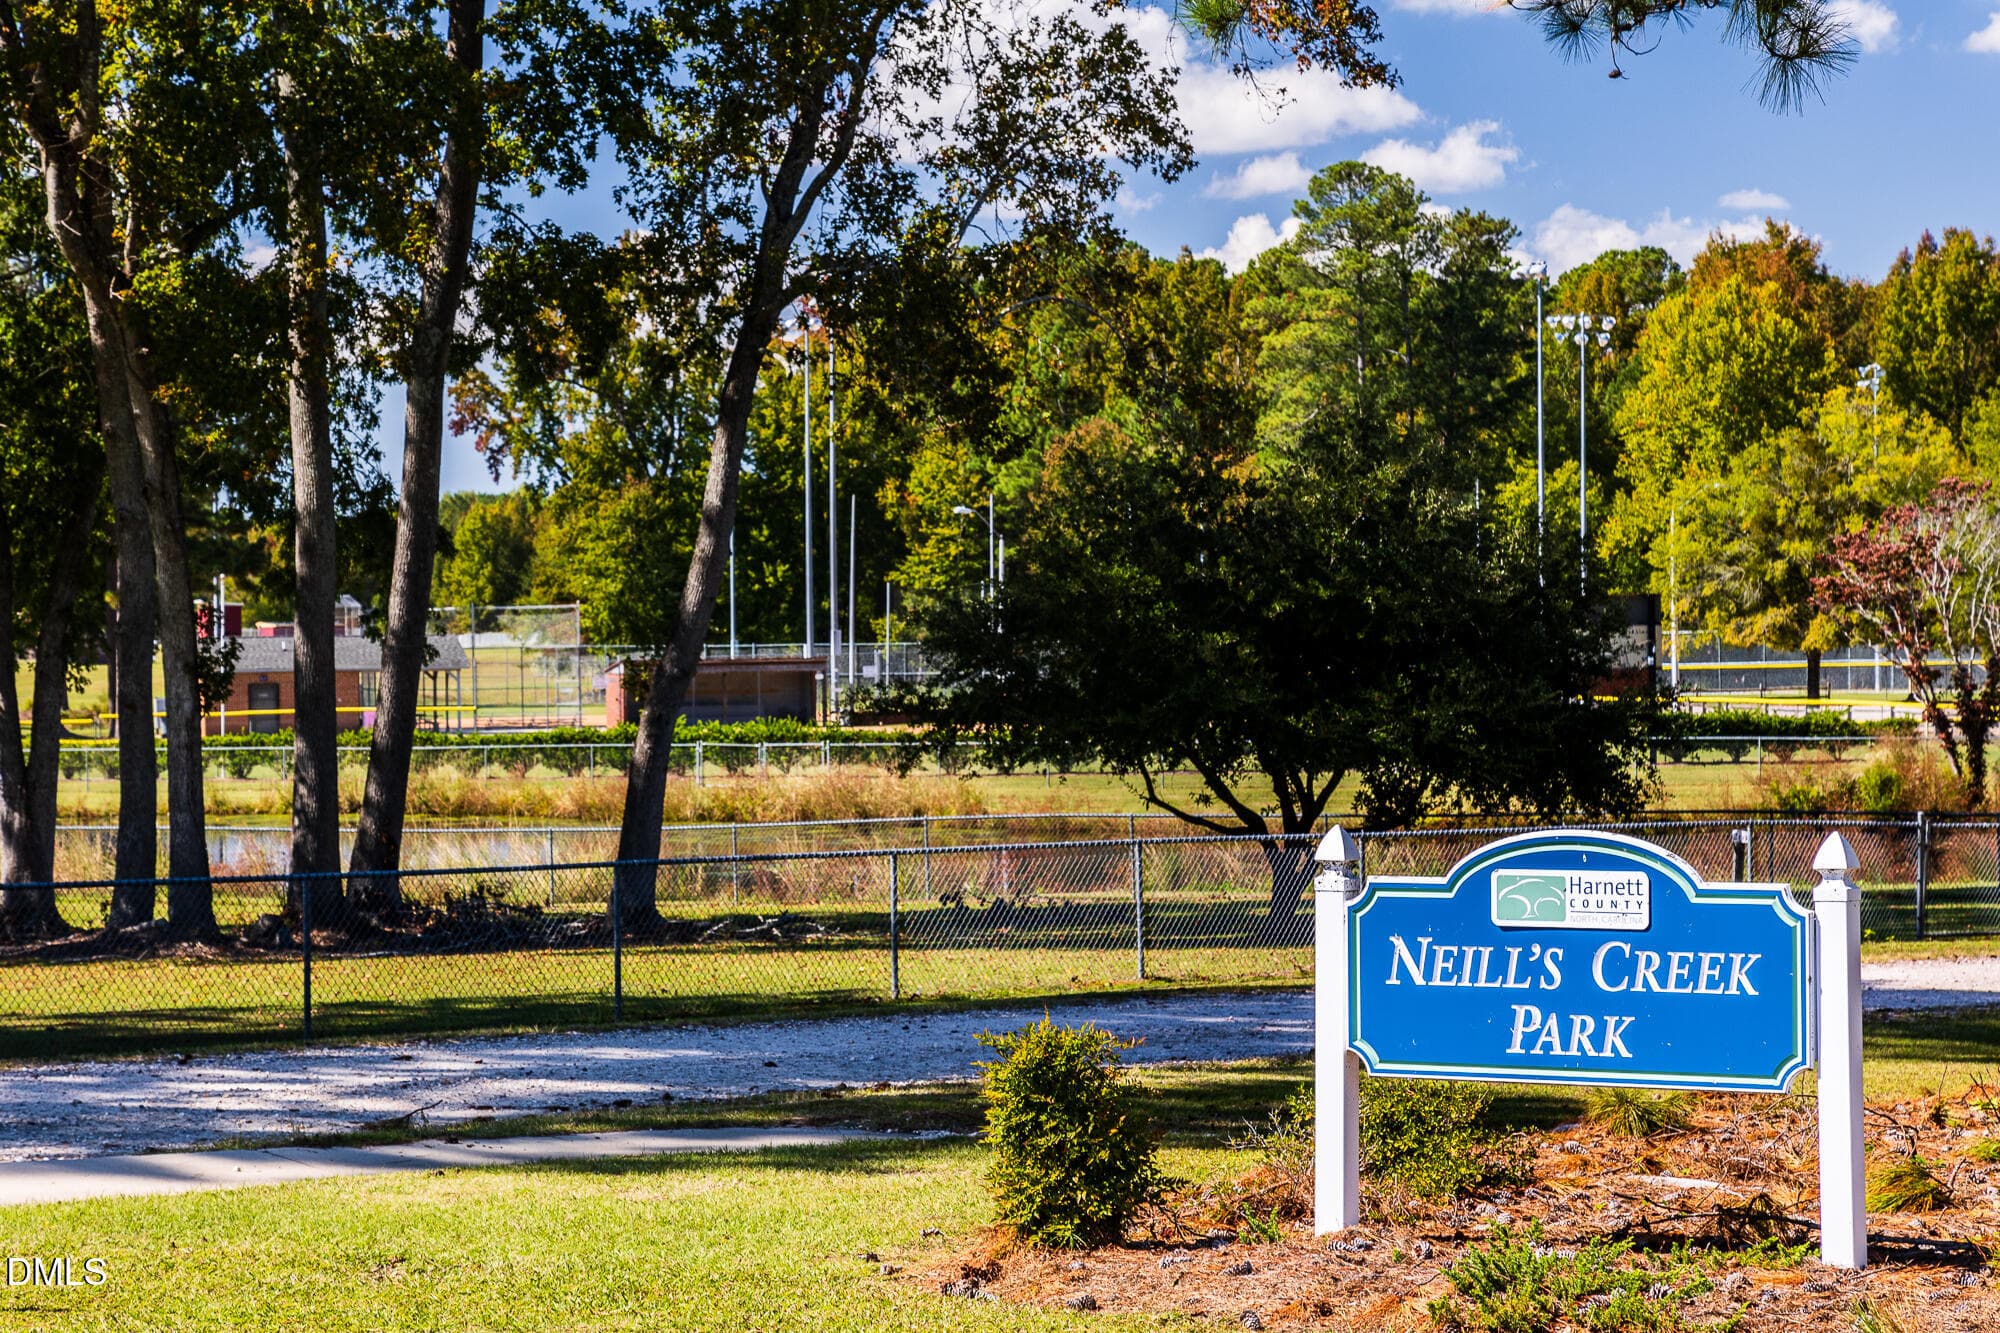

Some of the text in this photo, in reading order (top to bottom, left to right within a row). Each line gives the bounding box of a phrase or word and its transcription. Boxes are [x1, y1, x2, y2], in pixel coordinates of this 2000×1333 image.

[1569, 876, 1644, 896] Harnett
[1569, 898, 1643, 910] COUNTY
[1569, 914, 1643, 925] NORTH CAROLINA
[1592, 941, 1762, 996] CREEK
[1505, 1004, 1636, 1058] PARK
